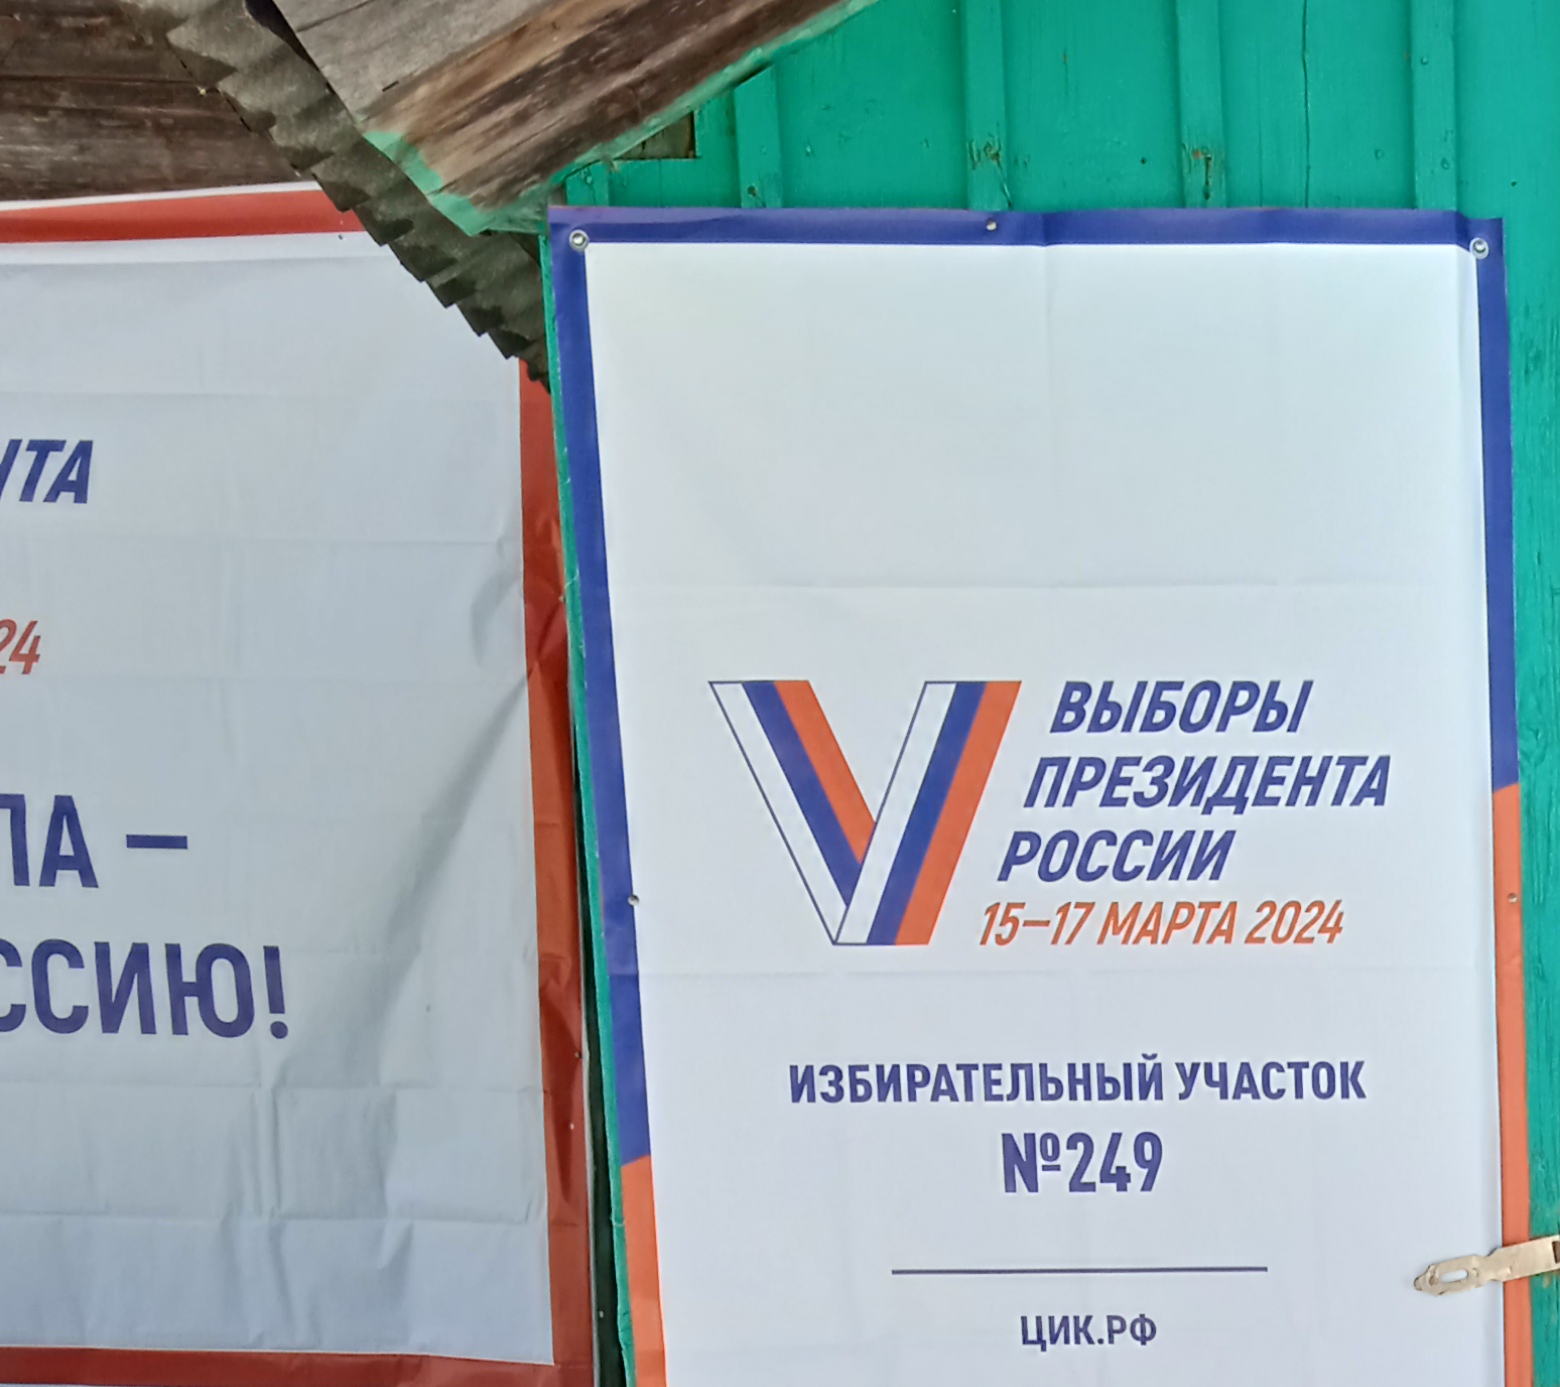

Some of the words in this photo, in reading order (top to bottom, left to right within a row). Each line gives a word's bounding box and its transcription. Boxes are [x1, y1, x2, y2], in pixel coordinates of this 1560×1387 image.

[1049, 680, 1314, 736] ВЫБОРЫ
[1023, 753, 1392, 816] ПРЕЗИДЕНТА
[997, 828, 1237, 883] РОССИИ
[979, 902, 1092, 947] 15–17
[1096, 901, 1238, 946] МАРТА
[1243, 899, 1344, 945] 2024
[789, 1054, 1165, 1104] ИЗБИРАТЕЛЬНЫЙ
[1177, 1060, 1367, 1101] УЧАСТОК
[1002, 1132, 1165, 1194] №249
[1020, 1313, 1158, 1352] ЦИК.РФ
